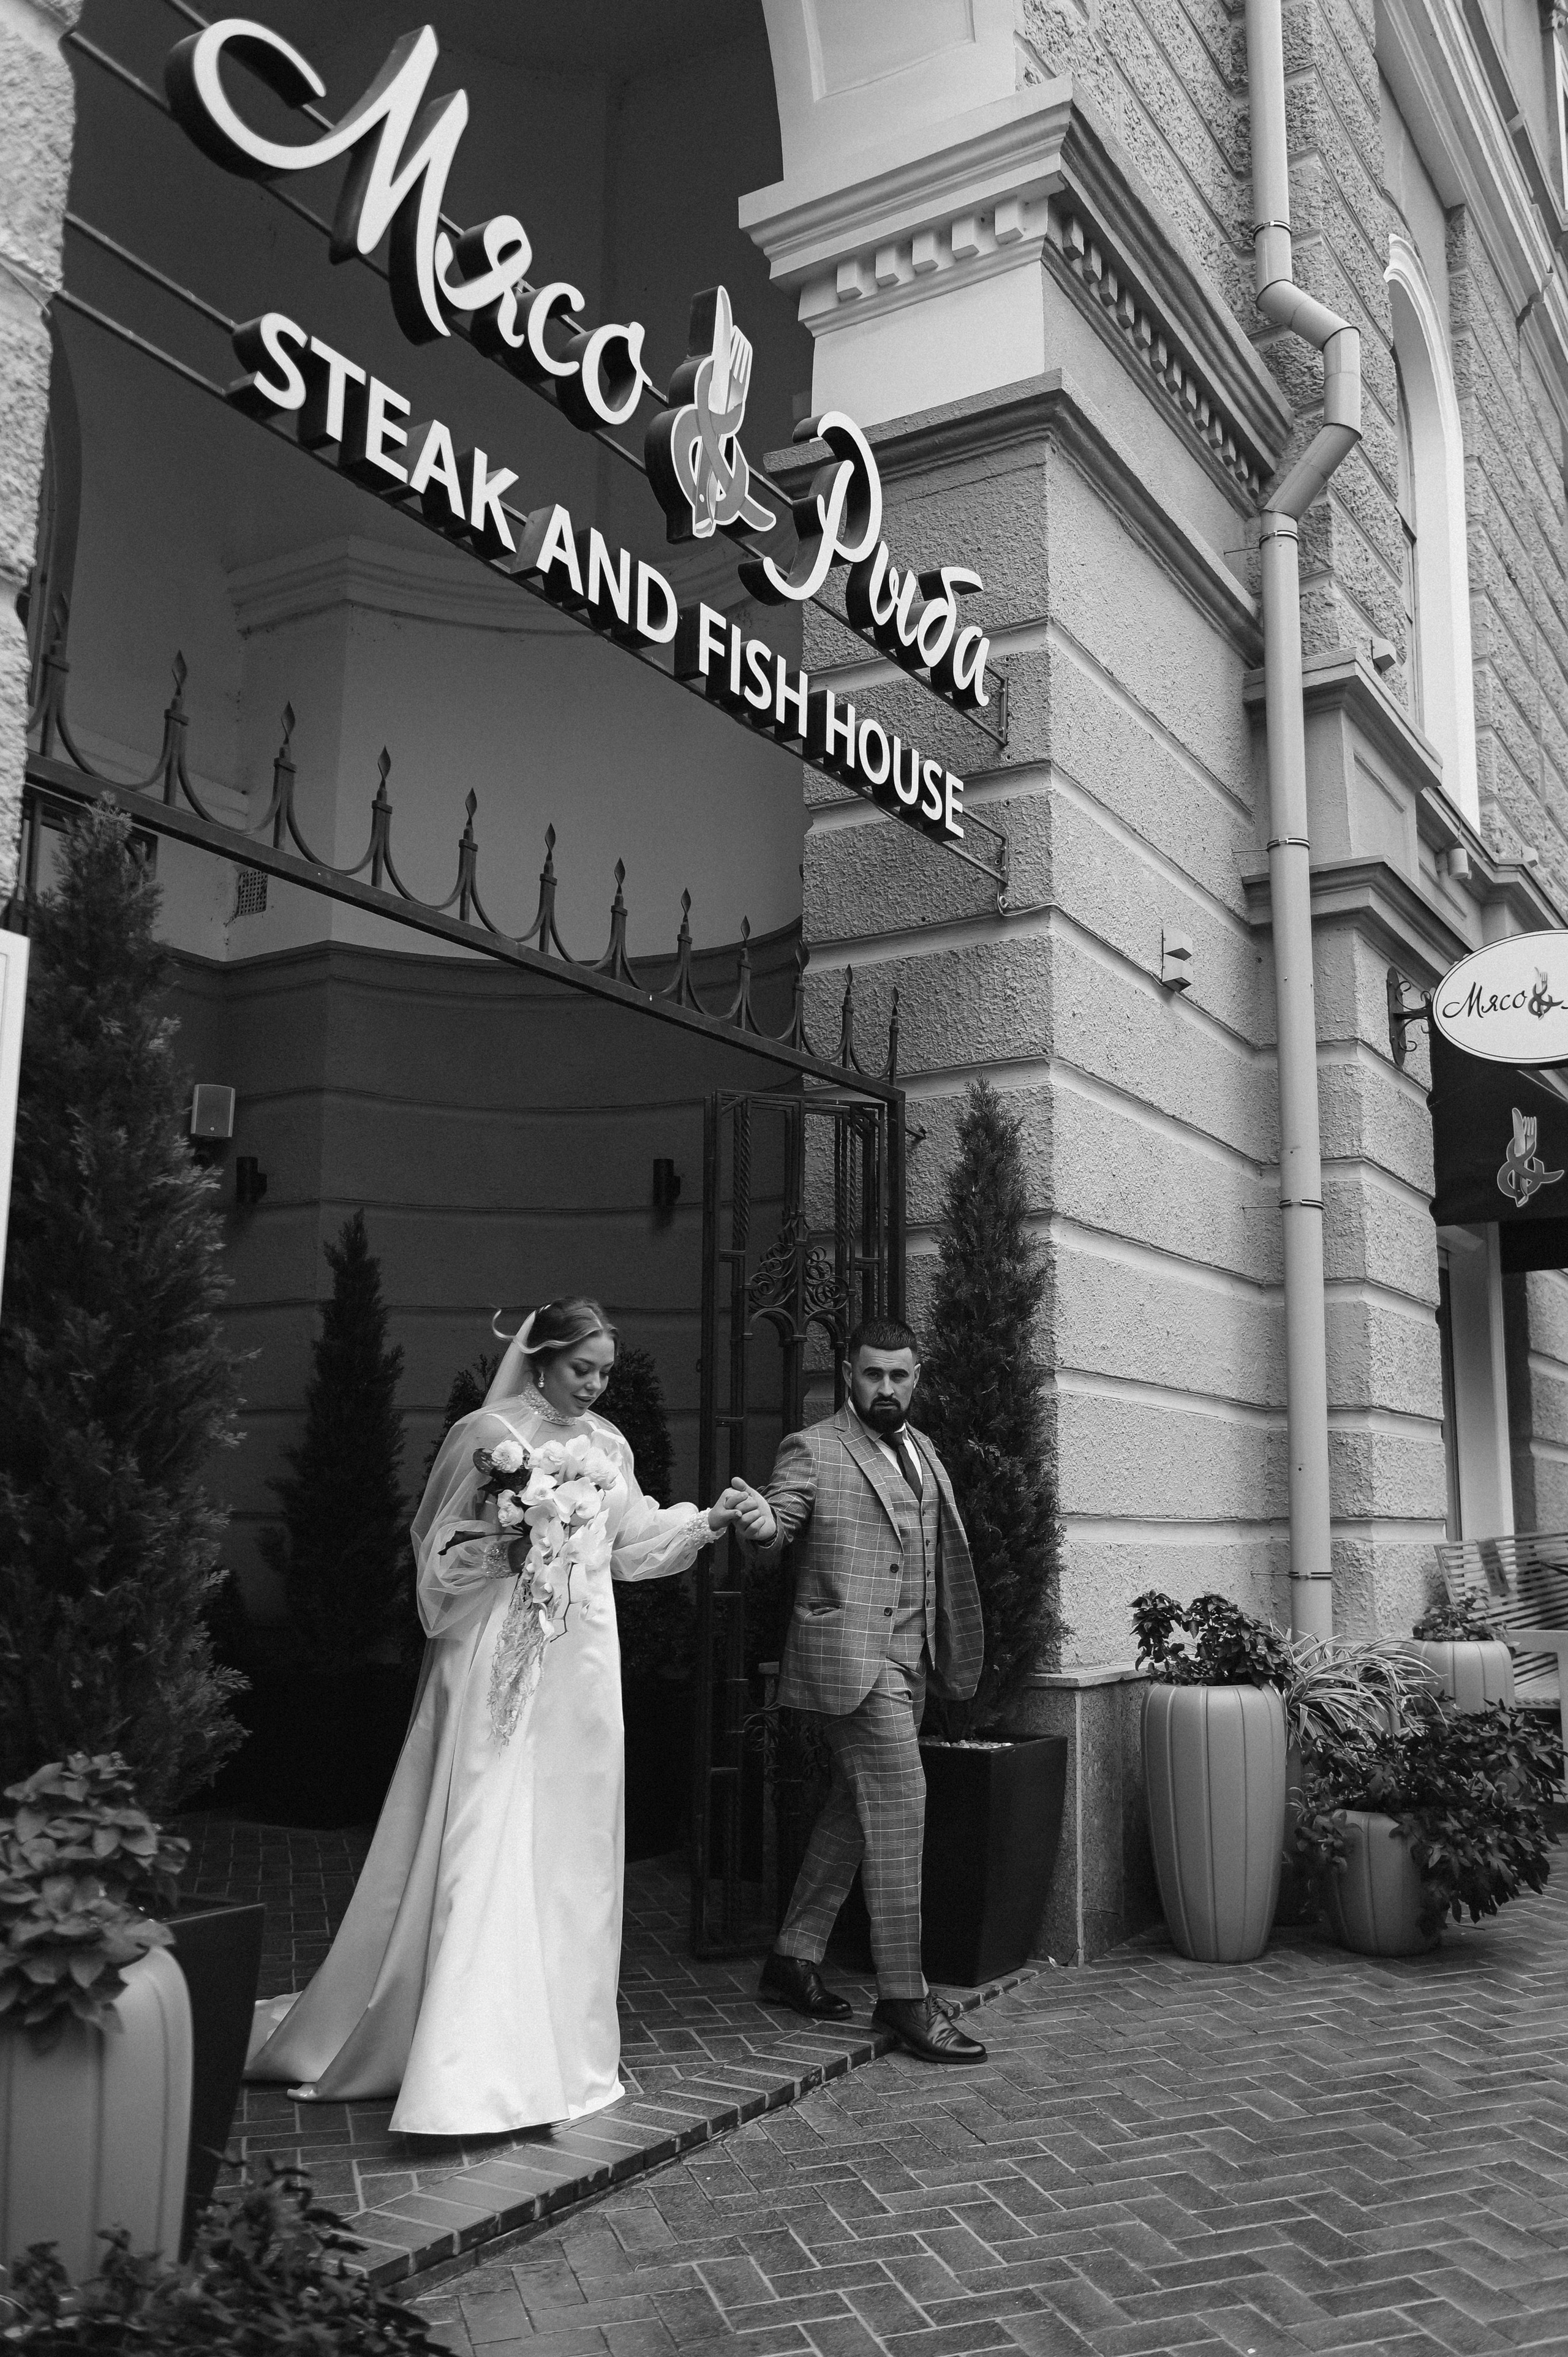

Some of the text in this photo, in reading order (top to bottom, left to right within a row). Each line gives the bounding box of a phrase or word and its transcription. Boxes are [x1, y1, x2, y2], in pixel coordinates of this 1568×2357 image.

[193, 18, 662, 425] Мясо
[764, 411, 990, 707] Рыба
[253, 312, 965, 839] STEAK AND FISH HOUSE
[1442, 981, 1528, 1019] Мясо
